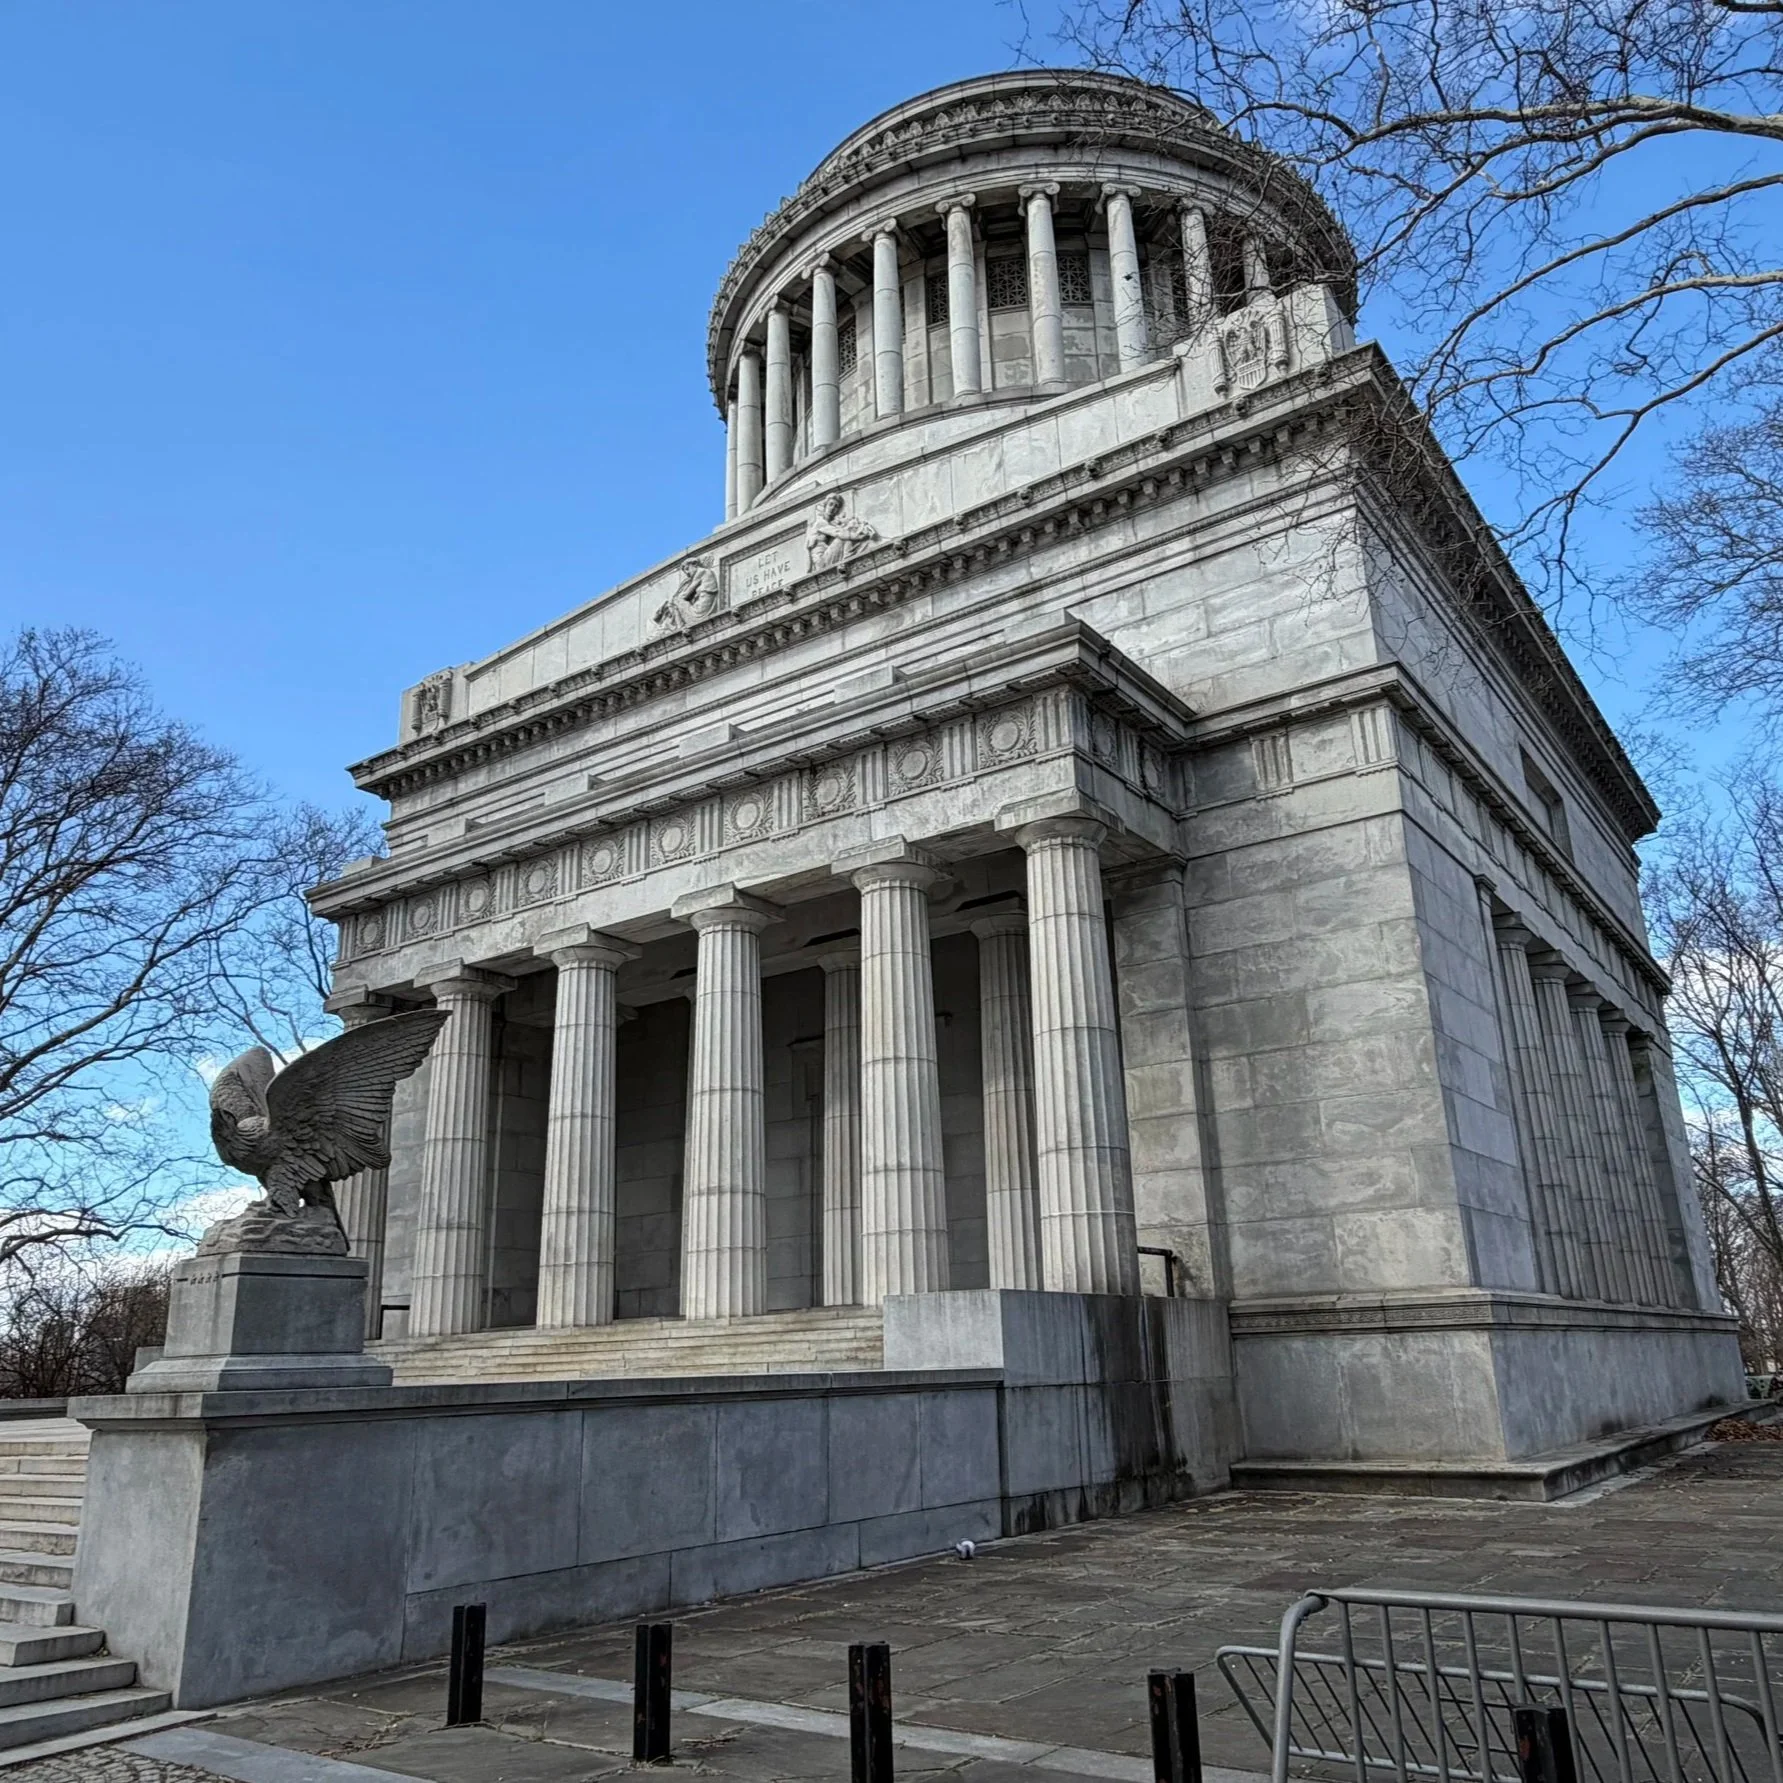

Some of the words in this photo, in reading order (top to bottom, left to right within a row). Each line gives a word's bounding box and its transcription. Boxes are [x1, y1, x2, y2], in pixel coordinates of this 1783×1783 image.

[758, 551, 778, 568] LET
[746, 574, 759, 587] US
[763, 561, 790, 582] HAVE
